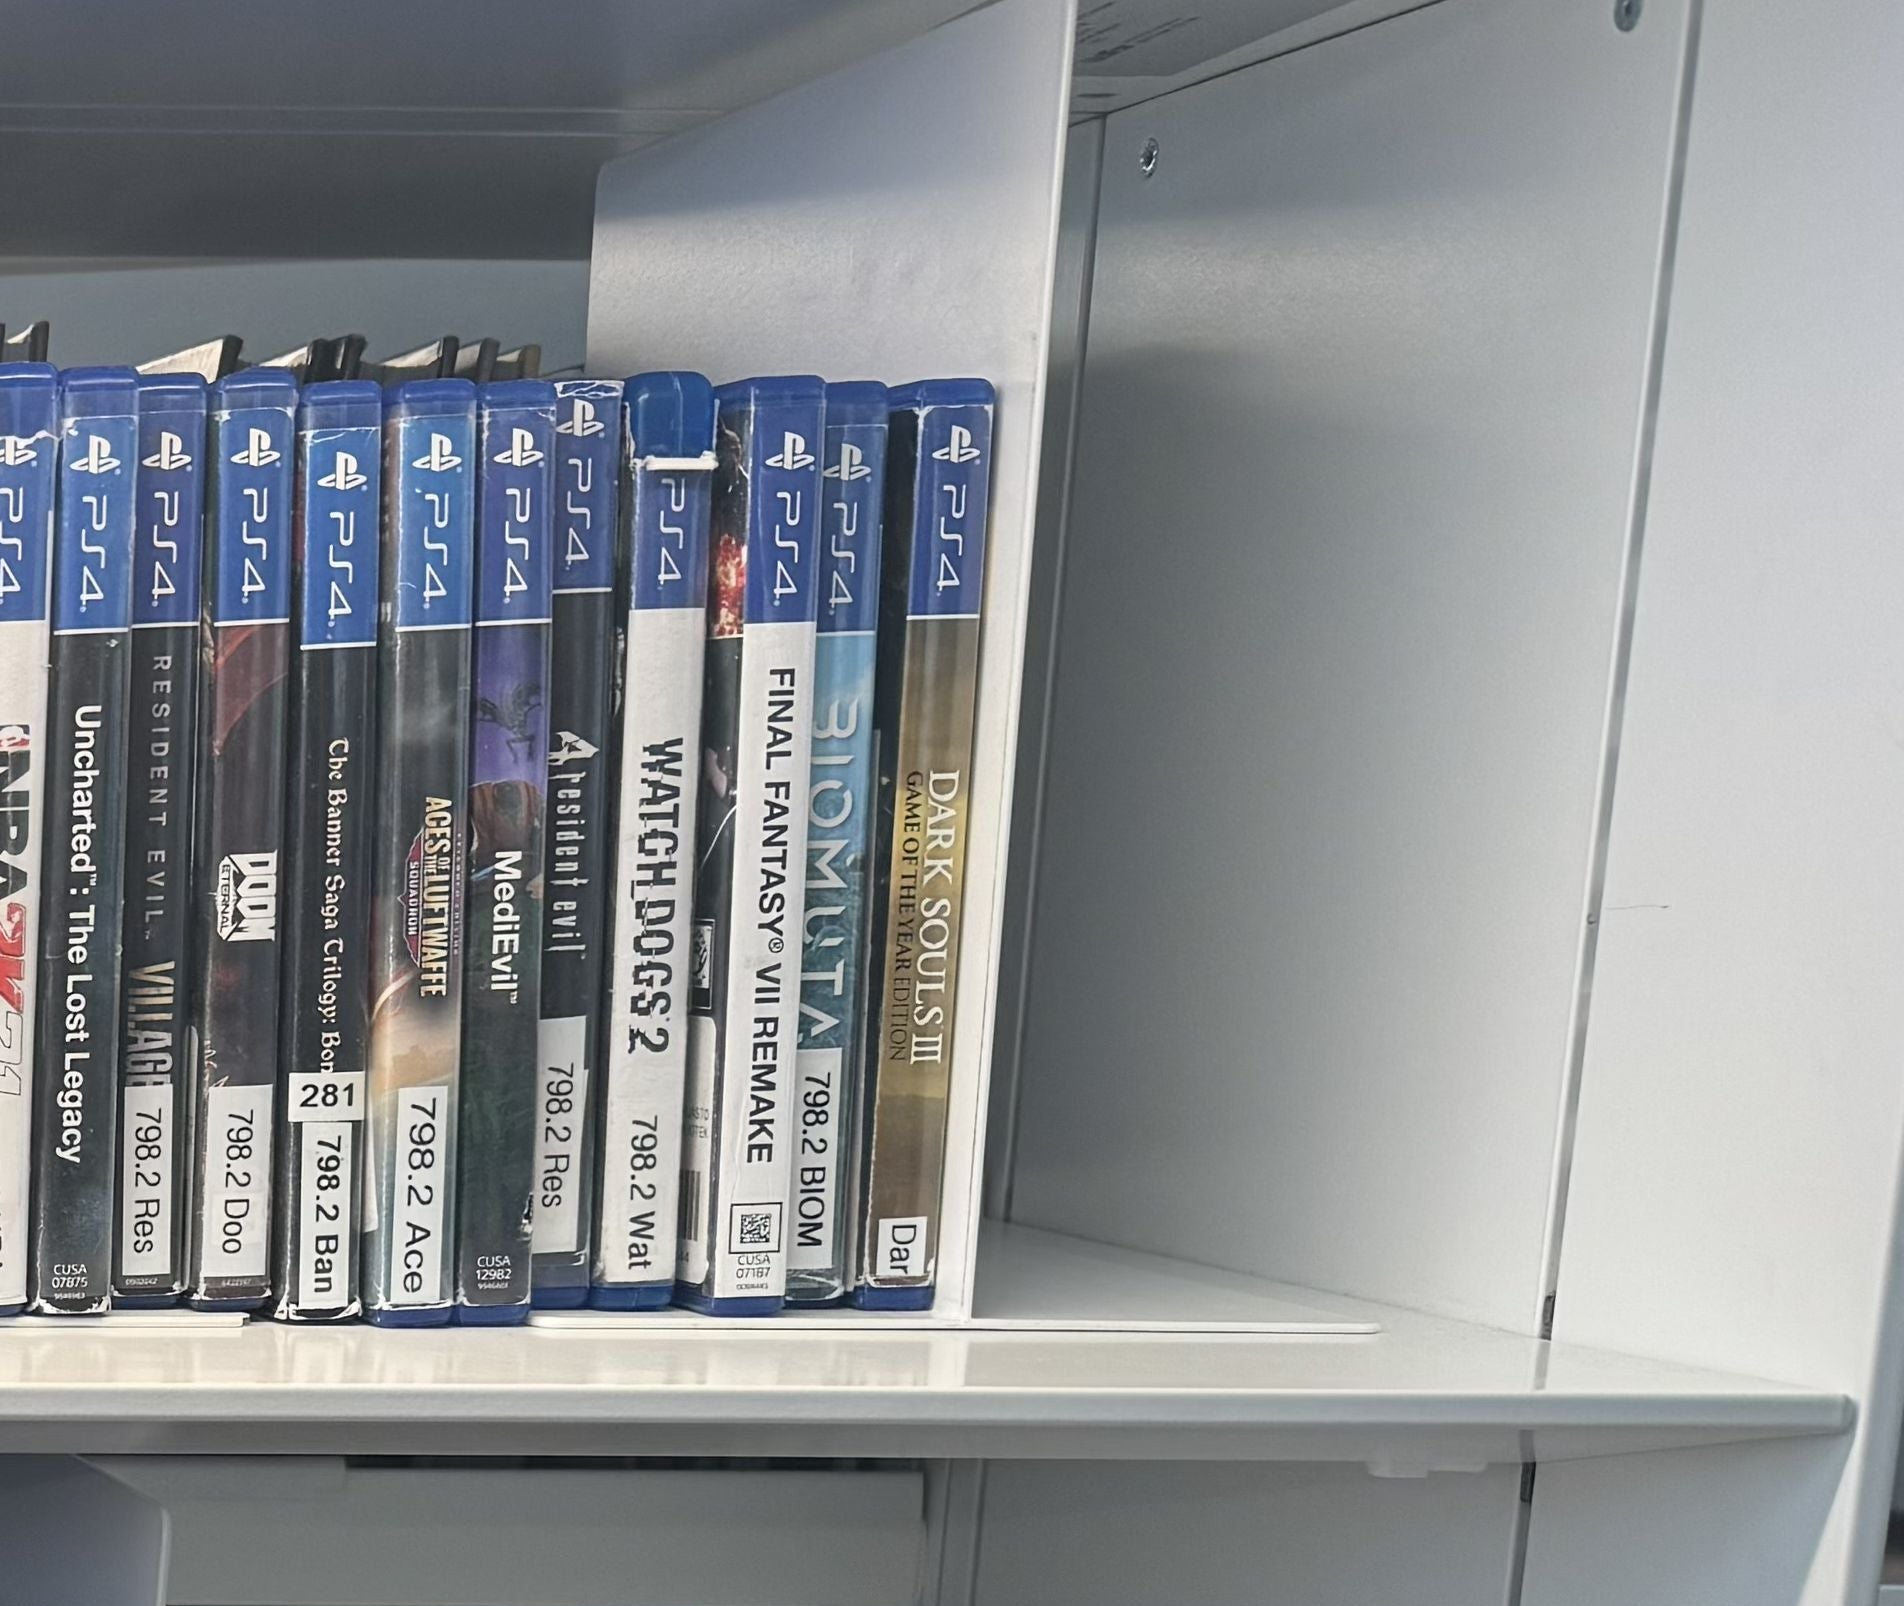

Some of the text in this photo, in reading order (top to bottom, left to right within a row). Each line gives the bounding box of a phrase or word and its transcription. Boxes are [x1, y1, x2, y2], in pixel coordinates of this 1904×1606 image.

[765, 667, 795, 770] FINAL
[753, 962, 783, 1010] VII
[909, 770, 960, 1064] DARK SOULS III
[56, 904, 95, 1165] The Lost Legacy
[299, 1082, 355, 1109] 281
[747, 1017, 779, 1165] REMAKE
[222, 1109, 253, 1256] 798.2 Doo
[314, 1136, 341, 1294] 798.2 Ban
[797, 1071, 832, 1248] 798.2 BIOM
[890, 1224, 917, 1275] Dar
